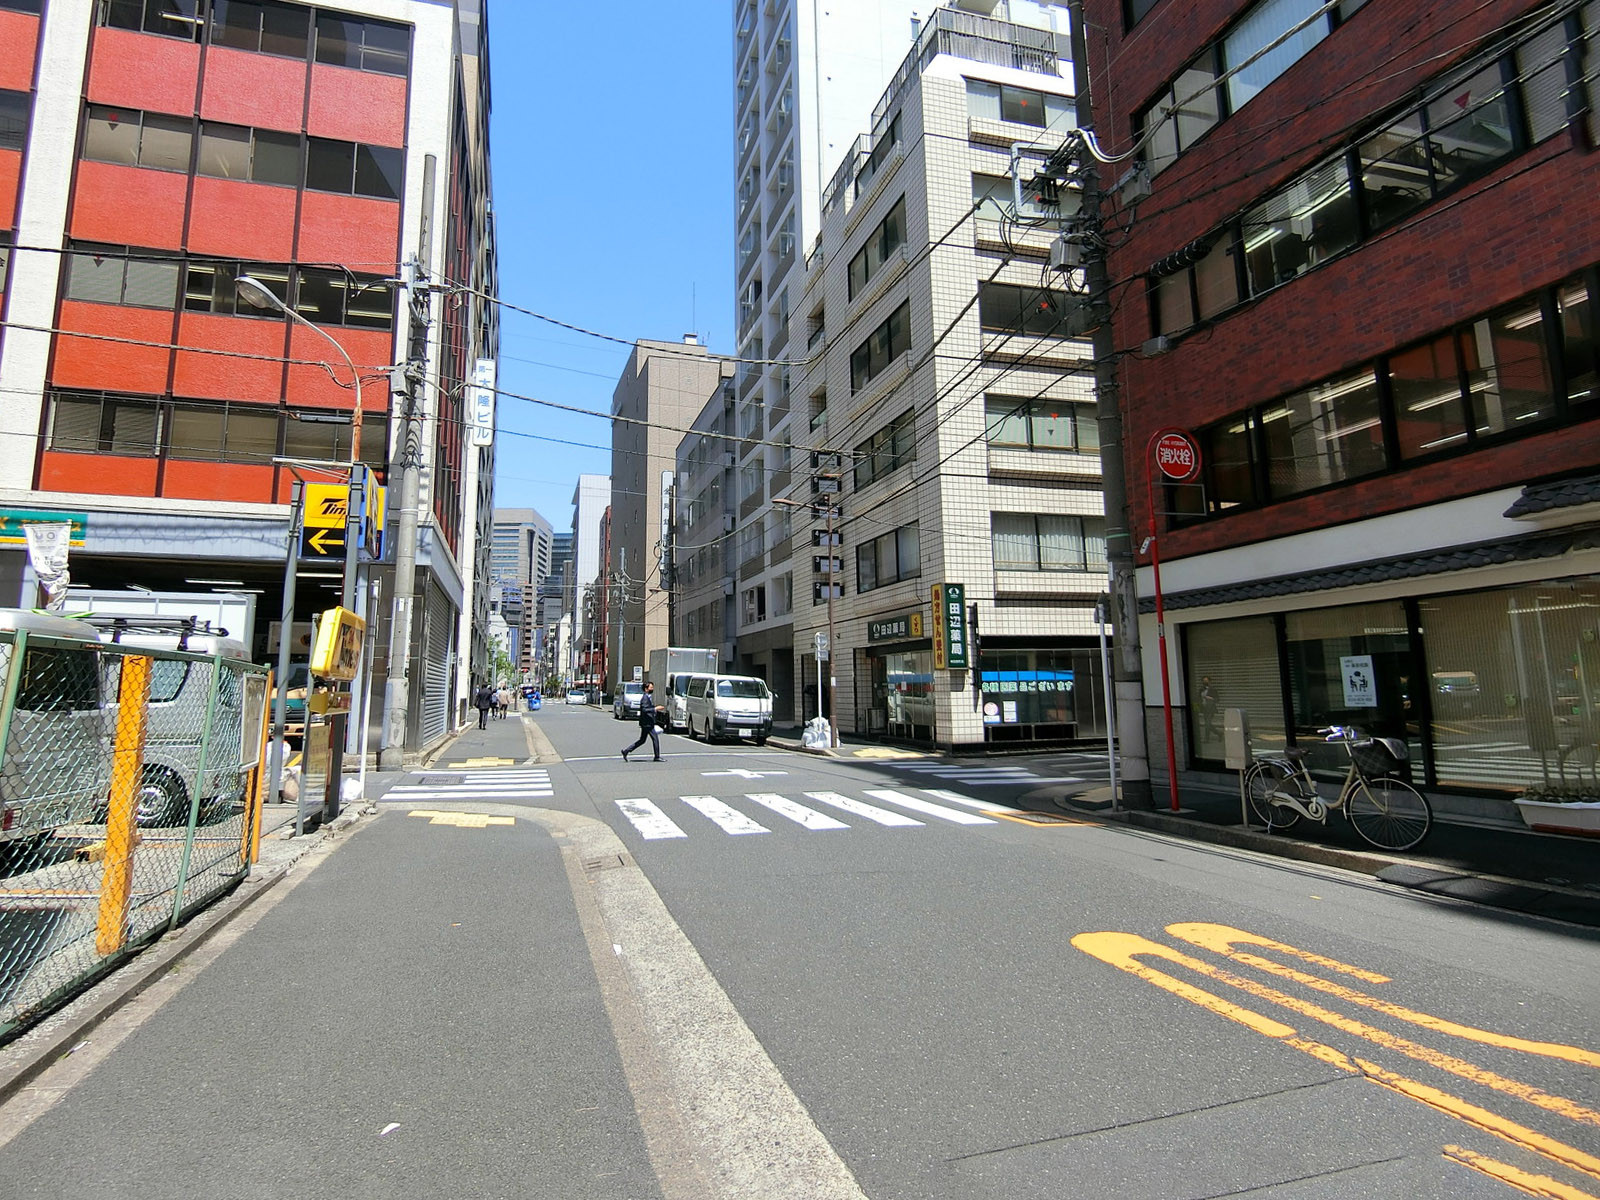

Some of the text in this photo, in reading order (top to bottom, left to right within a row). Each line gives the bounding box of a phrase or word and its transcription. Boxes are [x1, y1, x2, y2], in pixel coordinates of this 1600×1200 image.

[1160, 447, 1191, 465] 消火栓
[320, 498, 347, 515] Tim
[880, 621, 905, 636] 田辺薬局
[949, 602, 963, 655] 田辺薬局
